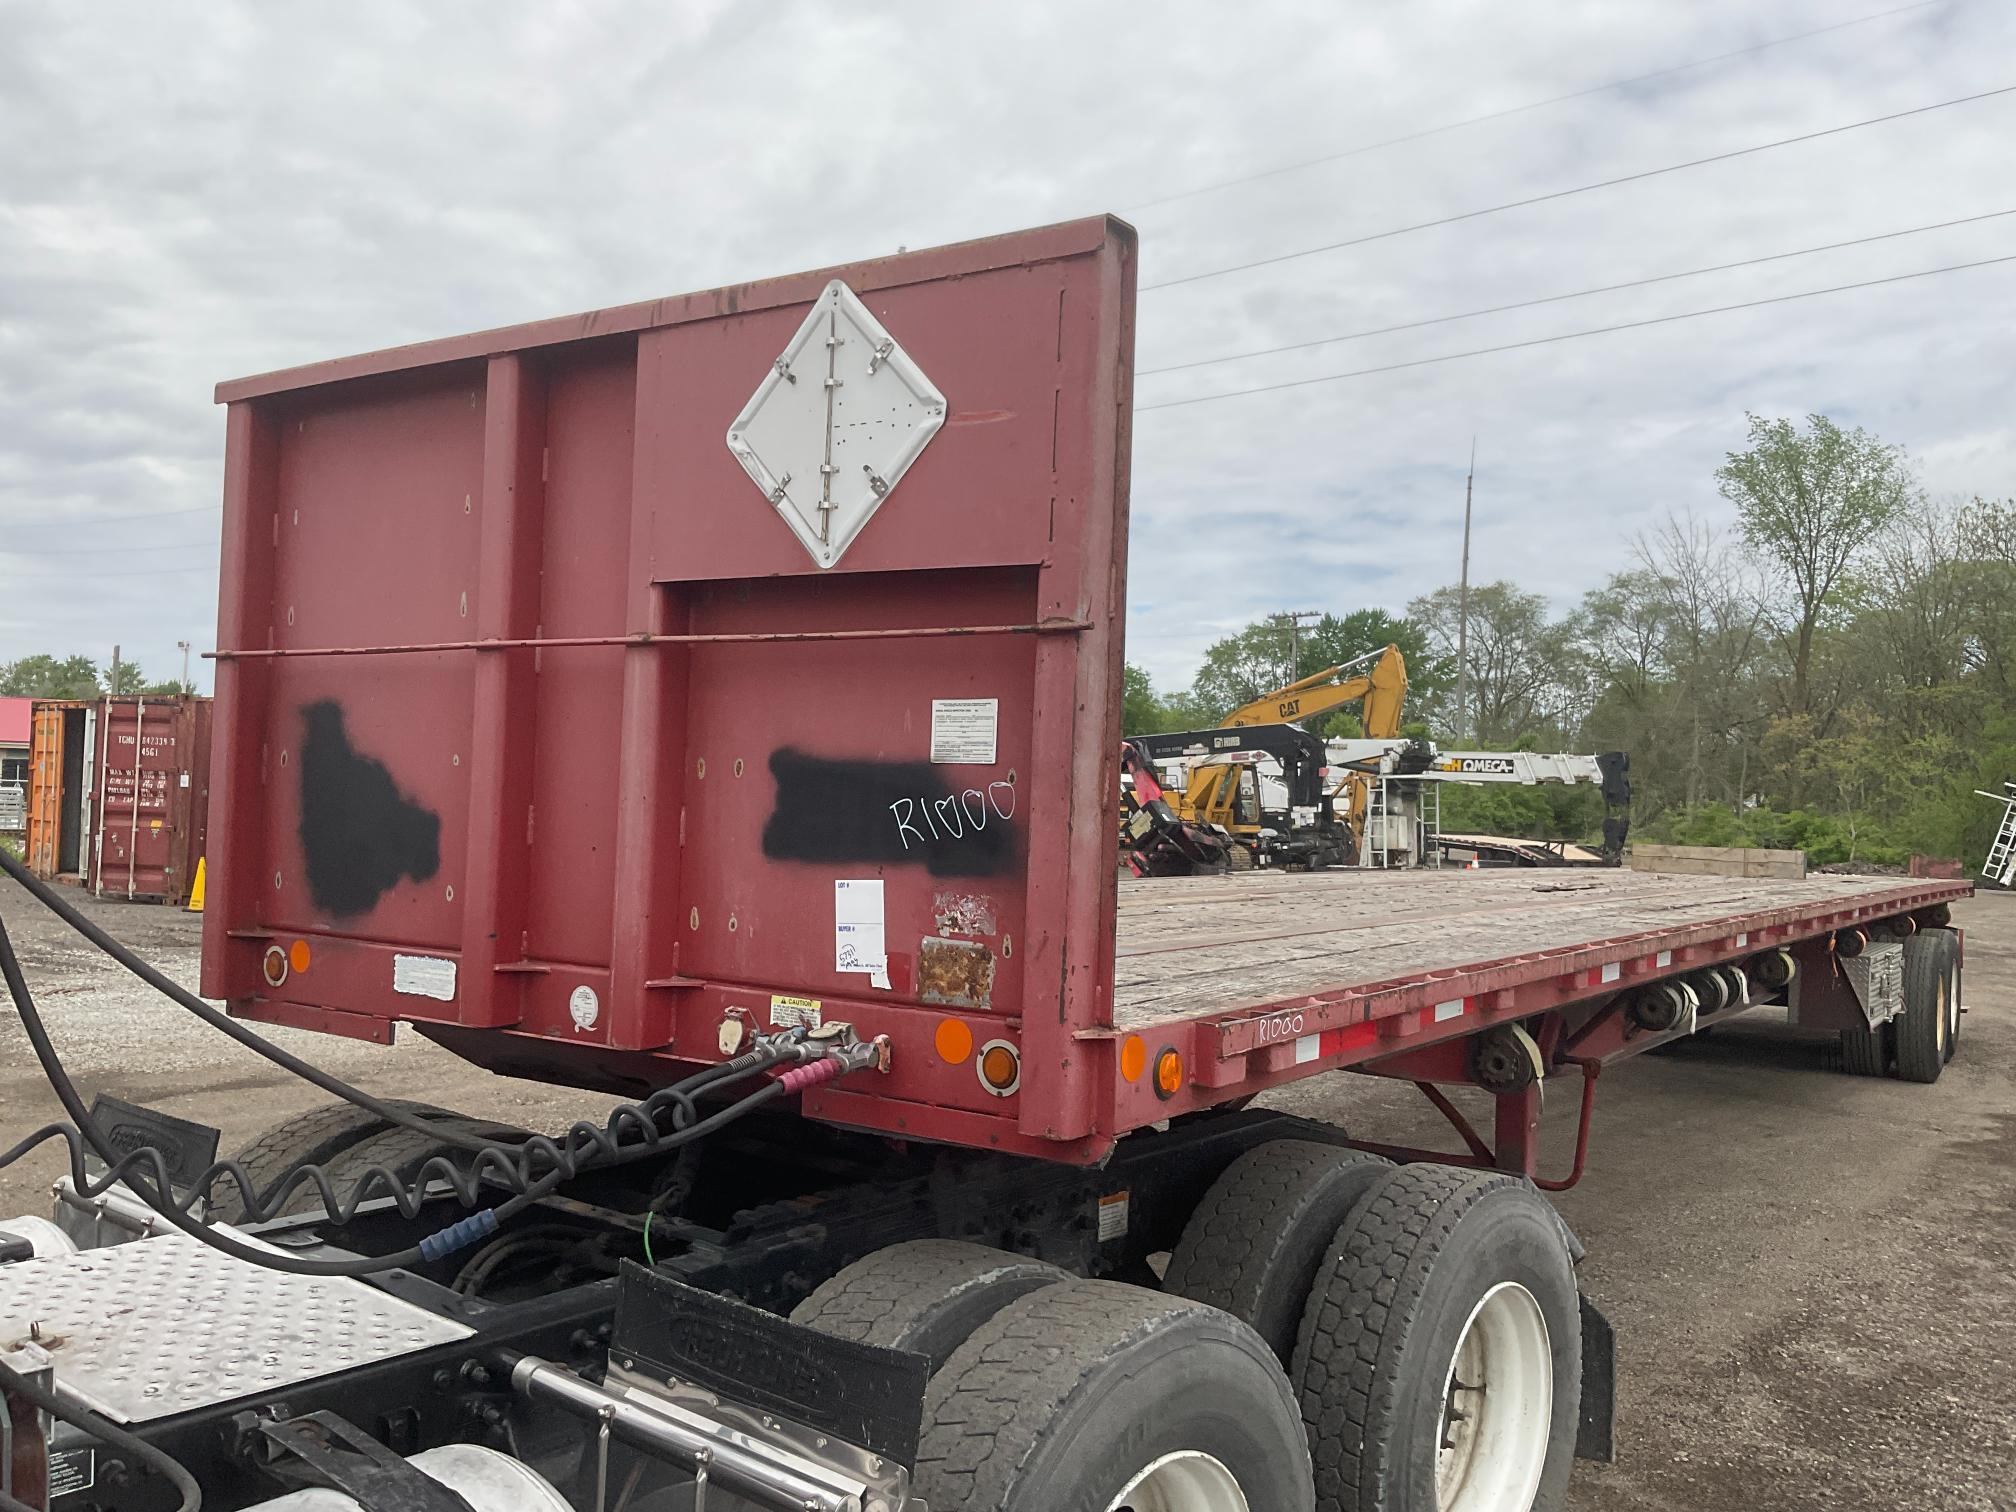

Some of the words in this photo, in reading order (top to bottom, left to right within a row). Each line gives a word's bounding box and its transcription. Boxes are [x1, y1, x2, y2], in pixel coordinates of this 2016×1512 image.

[1279, 699, 1300, 717] CAT
[1463, 760, 1509, 773] OMEGA
[889, 781, 1015, 850] R1000
[788, 998, 812, 1007] CAUTION
[1260, 1014, 1304, 1044] R1000
